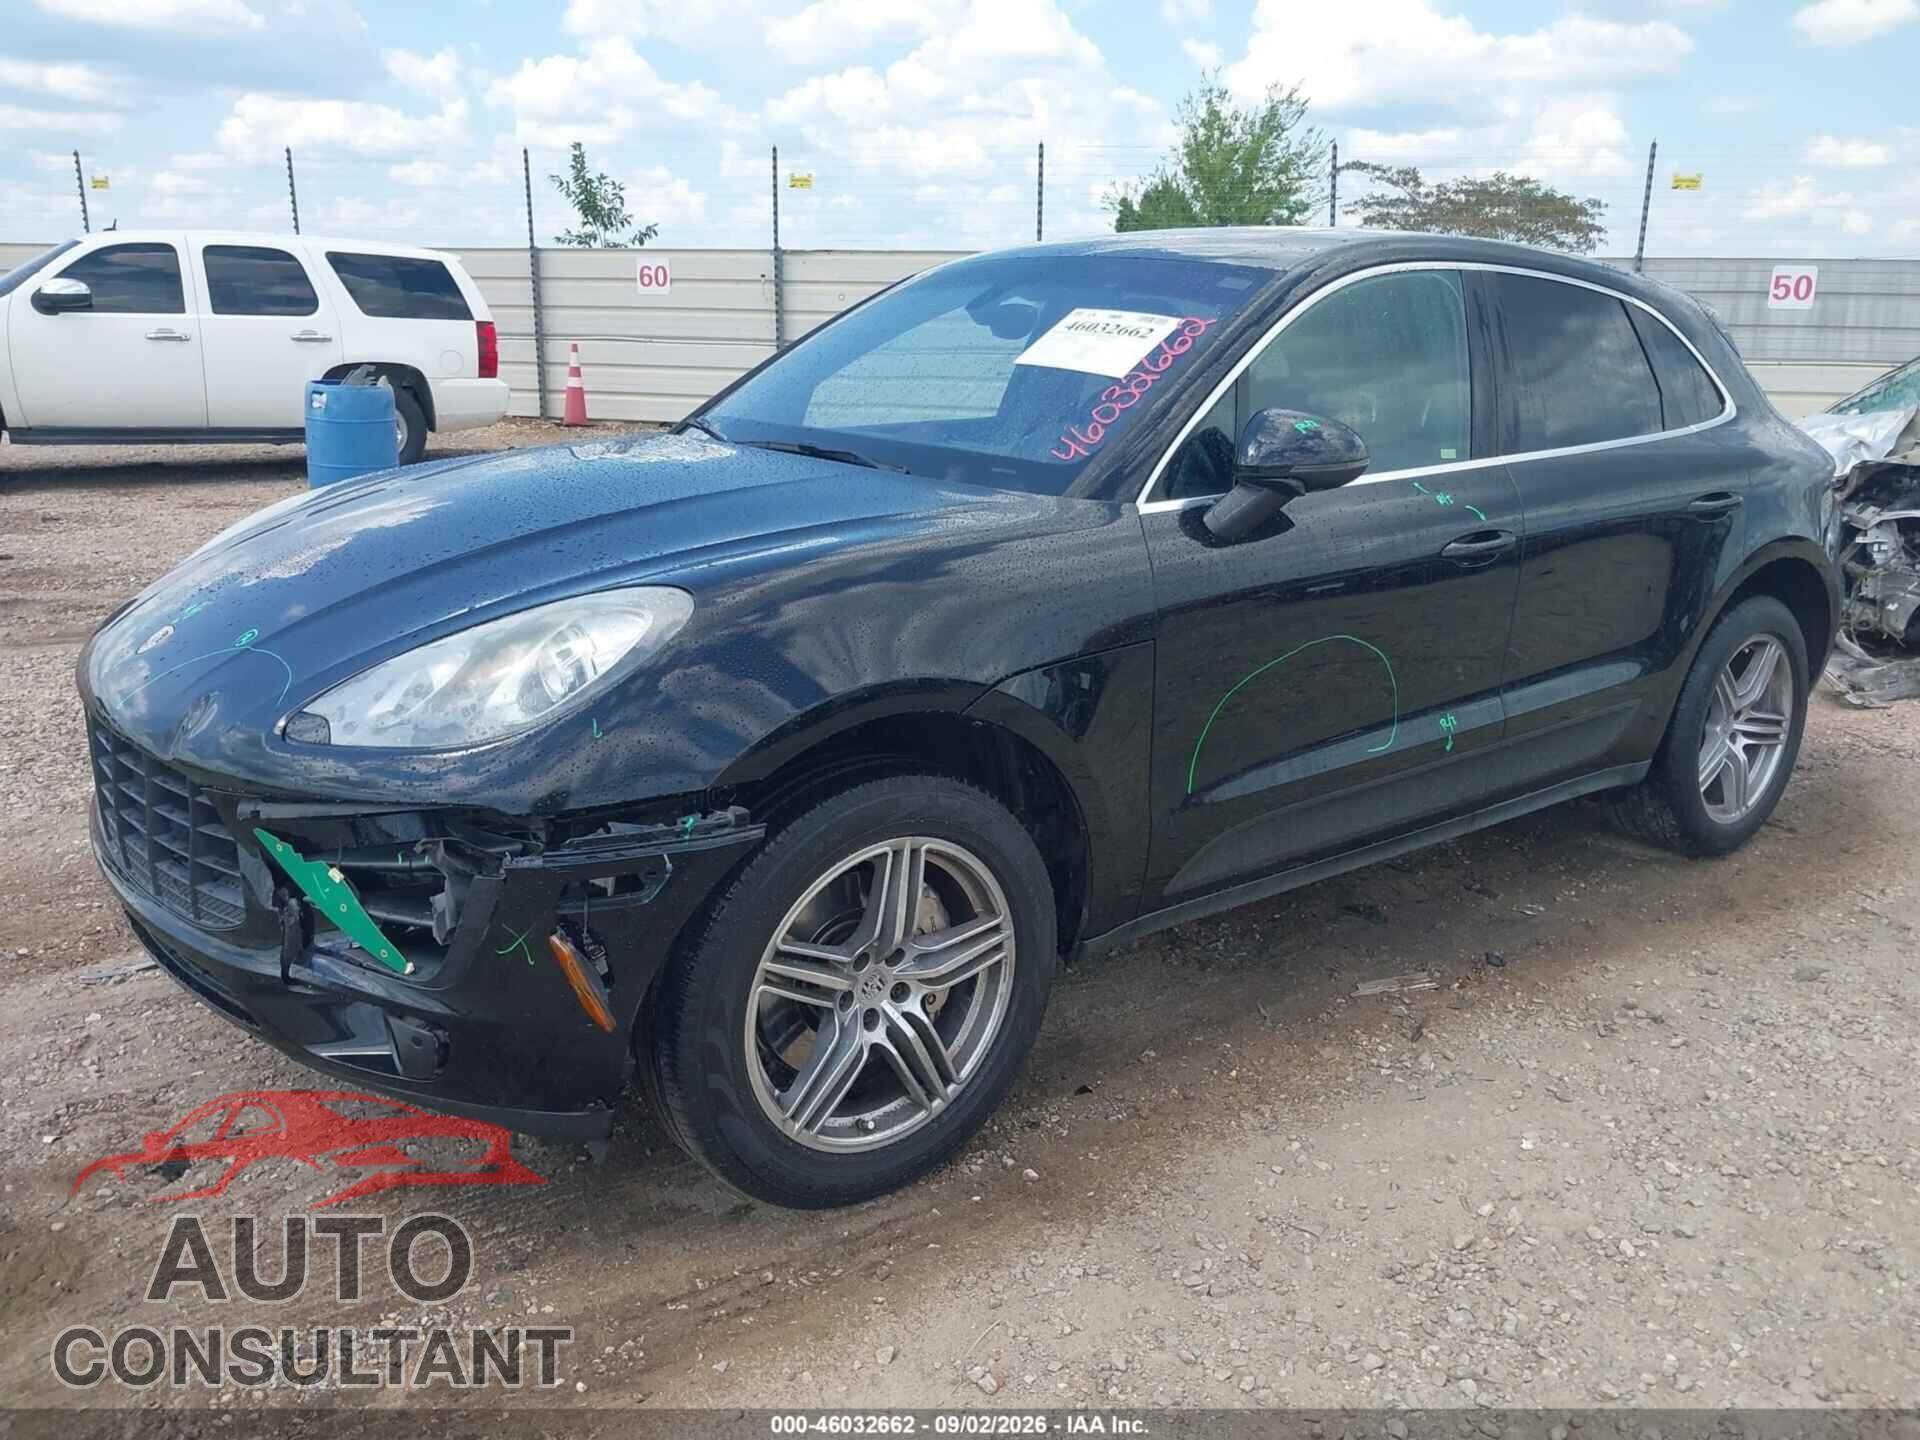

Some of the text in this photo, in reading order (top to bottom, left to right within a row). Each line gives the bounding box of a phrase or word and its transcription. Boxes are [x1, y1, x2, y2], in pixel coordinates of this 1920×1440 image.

[639, 265, 668, 287] 60
[1772, 274, 1813, 301] 50
[1065, 320, 1155, 339] 46032662
[1051, 315, 1217, 461] 46032662
